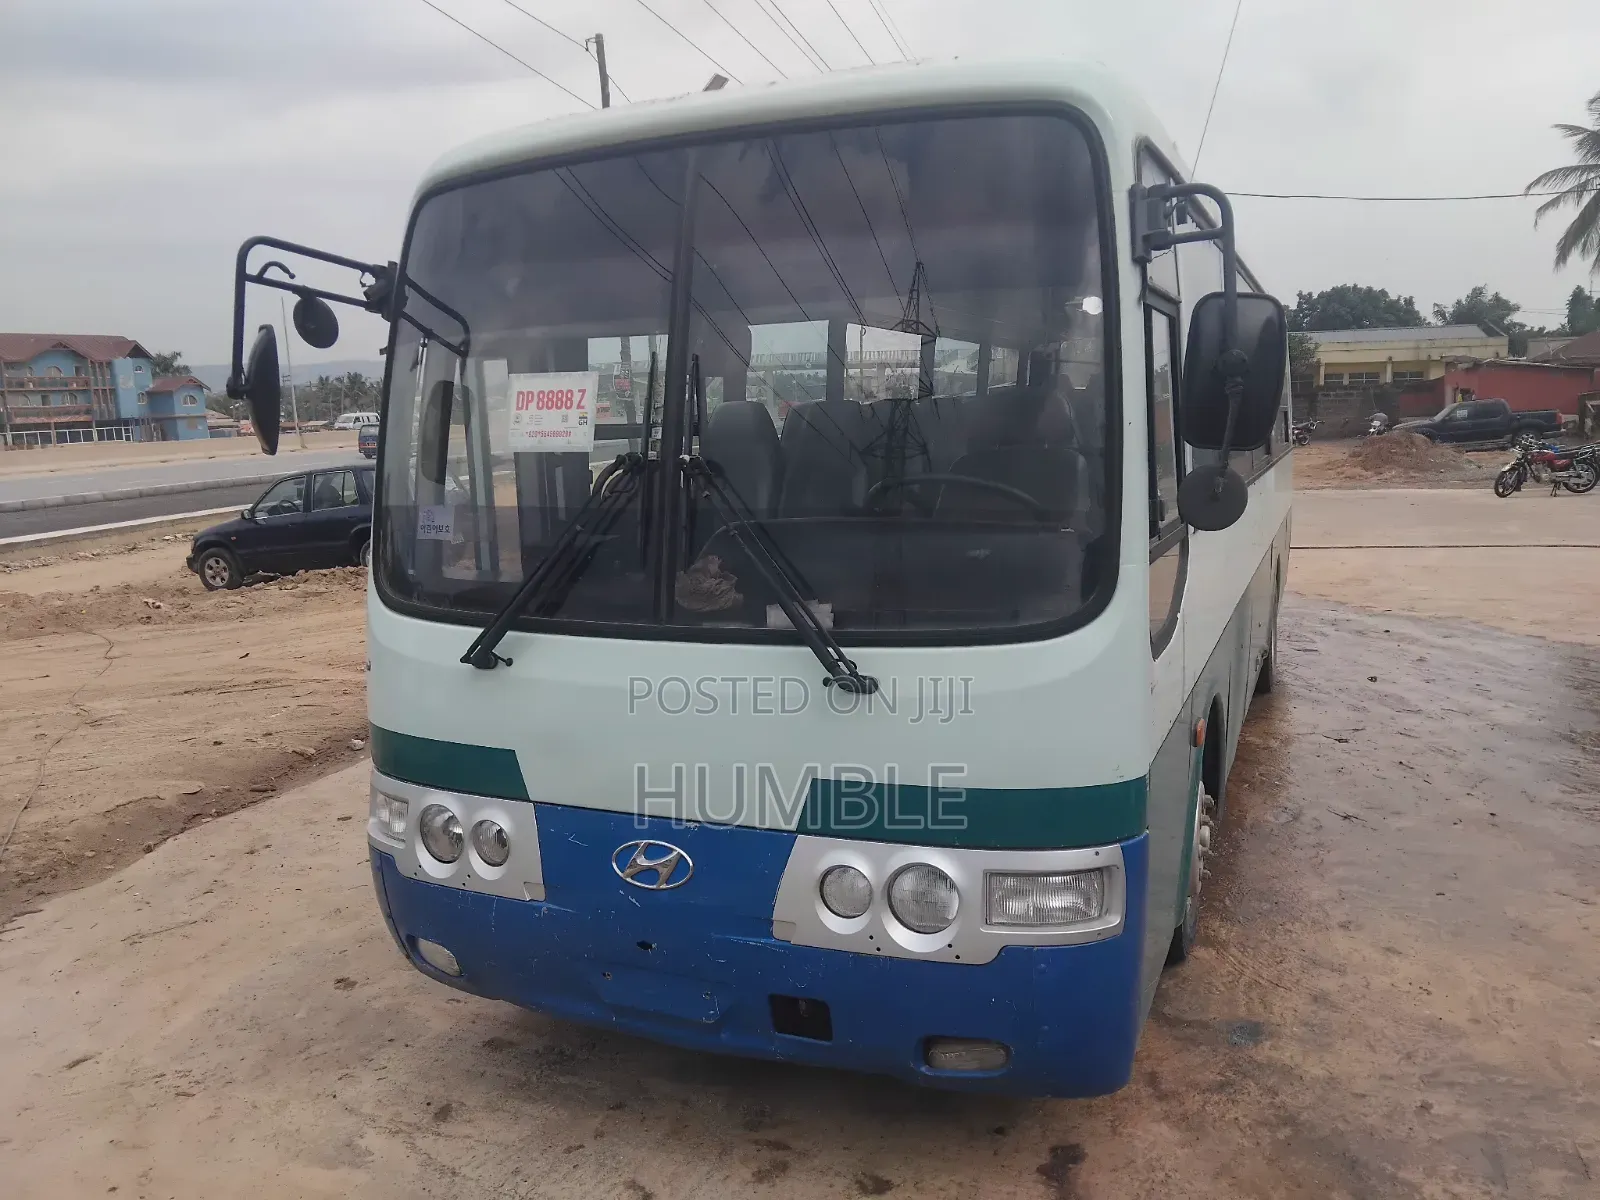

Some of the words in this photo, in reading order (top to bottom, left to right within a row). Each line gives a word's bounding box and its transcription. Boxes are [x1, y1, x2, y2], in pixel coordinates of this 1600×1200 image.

[515, 390, 534, 411] DP
[536, 388, 574, 410] 8888
[576, 388, 587, 410] Z
